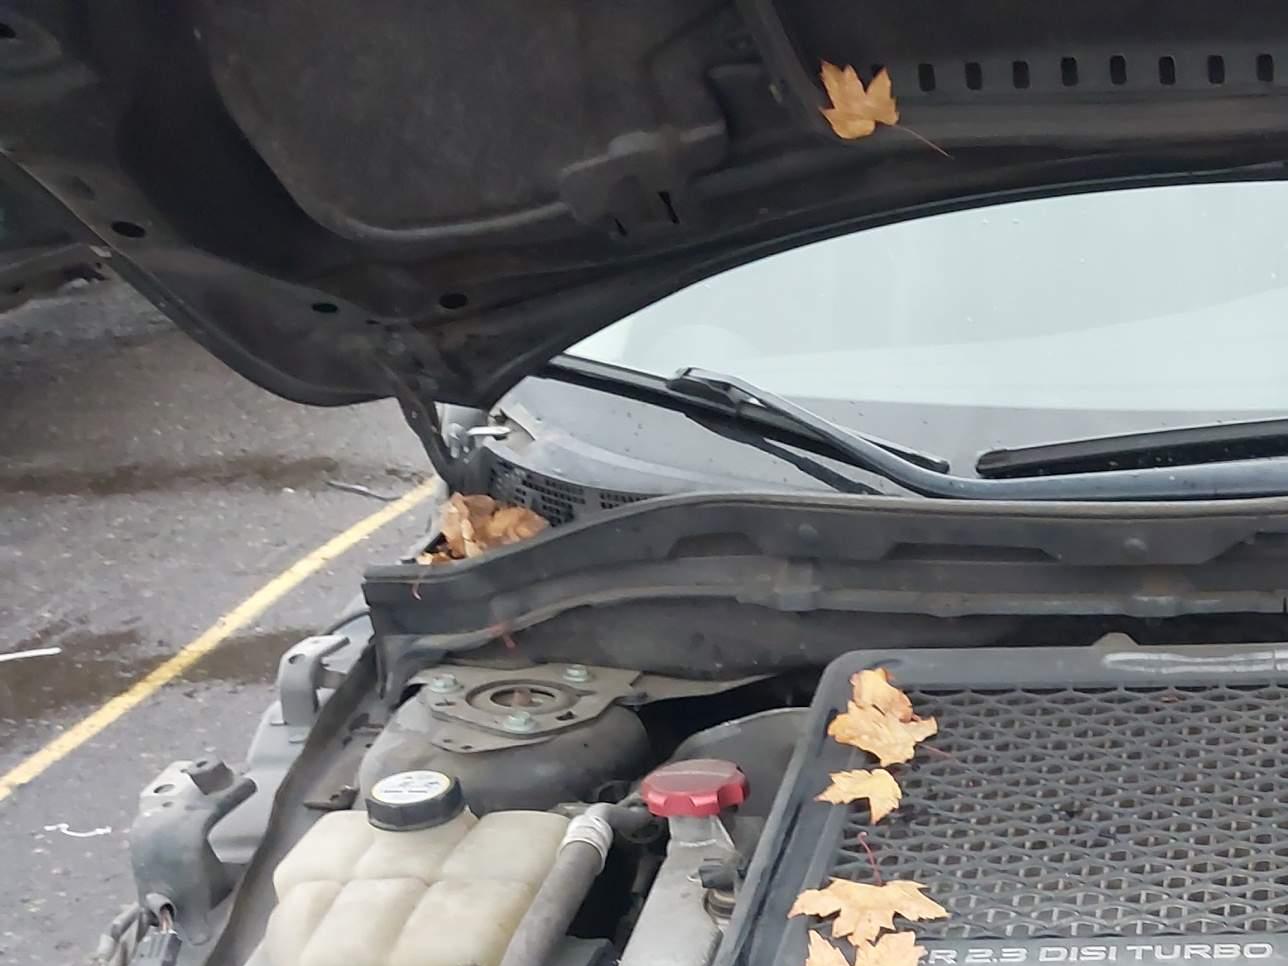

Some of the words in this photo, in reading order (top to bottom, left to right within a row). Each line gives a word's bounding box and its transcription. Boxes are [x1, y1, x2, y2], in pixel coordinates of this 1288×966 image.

[965, 947, 1027, 963] 2.3
[1038, 945, 1117, 962] DISI
[1126, 943, 1273, 960] TURBO
